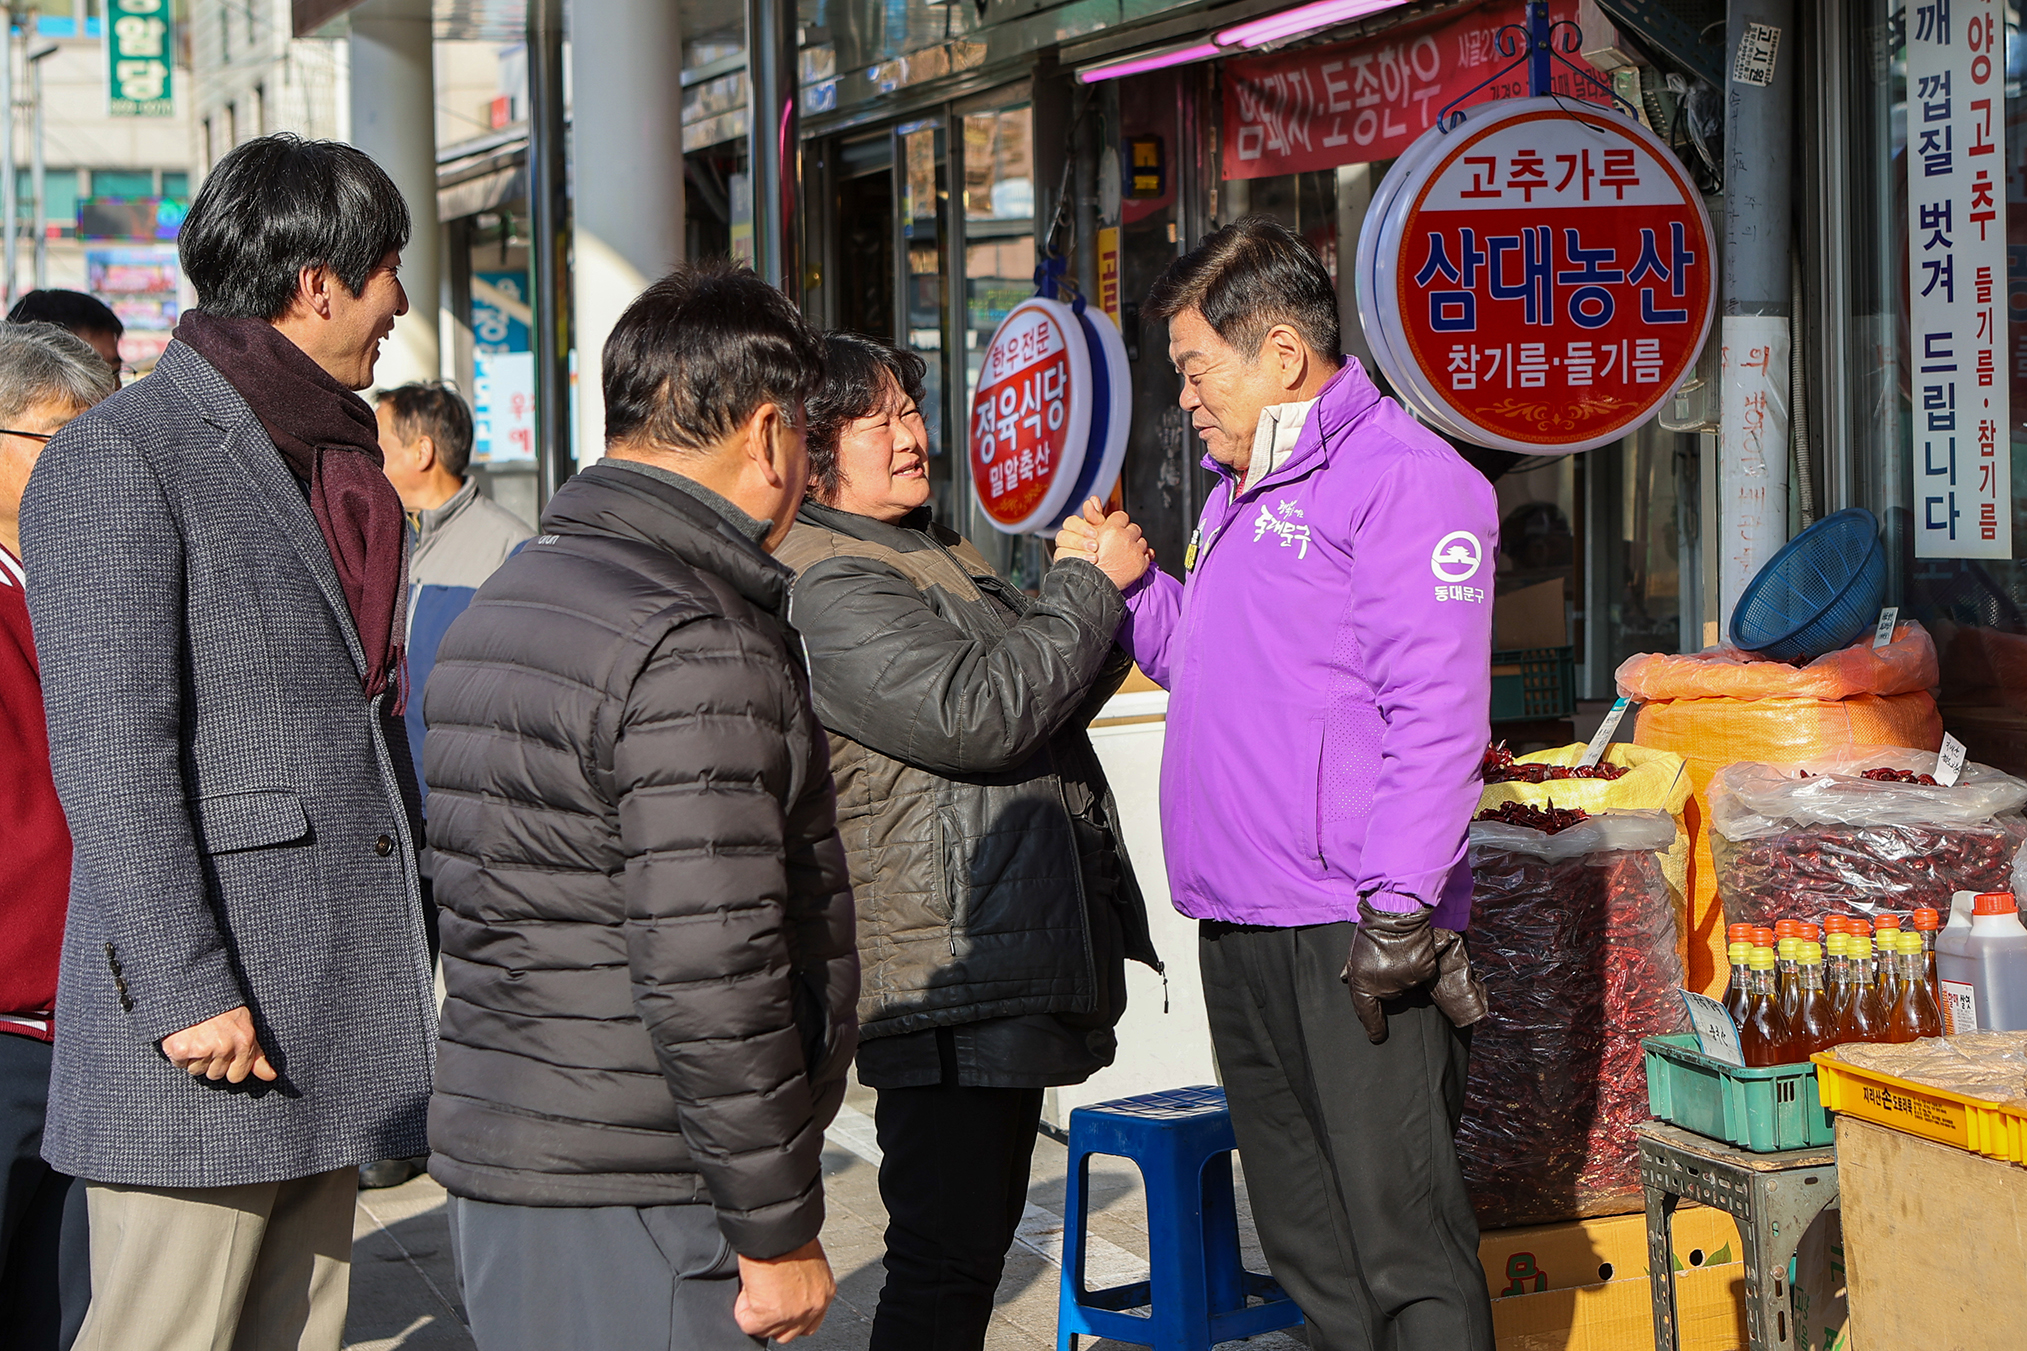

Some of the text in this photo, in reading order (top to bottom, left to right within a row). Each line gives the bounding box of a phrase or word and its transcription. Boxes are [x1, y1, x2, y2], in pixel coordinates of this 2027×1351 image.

[1748, 27, 1773, 83] 고시원
[1917, 70, 1953, 178] 껍질
[1967, 0, 1997, 241] 양고추
[1460, 148, 1640, 202] 고추가루
[1414, 221, 1695, 333] 삼대농산
[1920, 199, 1954, 303] 벗겨
[991, 319, 1051, 379] 한우전문
[975, 359, 1068, 465] 정육식당
[1920, 331, 1961, 541] 드립니다
[989, 440, 1051, 499] 밀알축산
[1253, 504, 1312, 560] 동대문구
[1434, 585, 1485, 604] 동대문구
